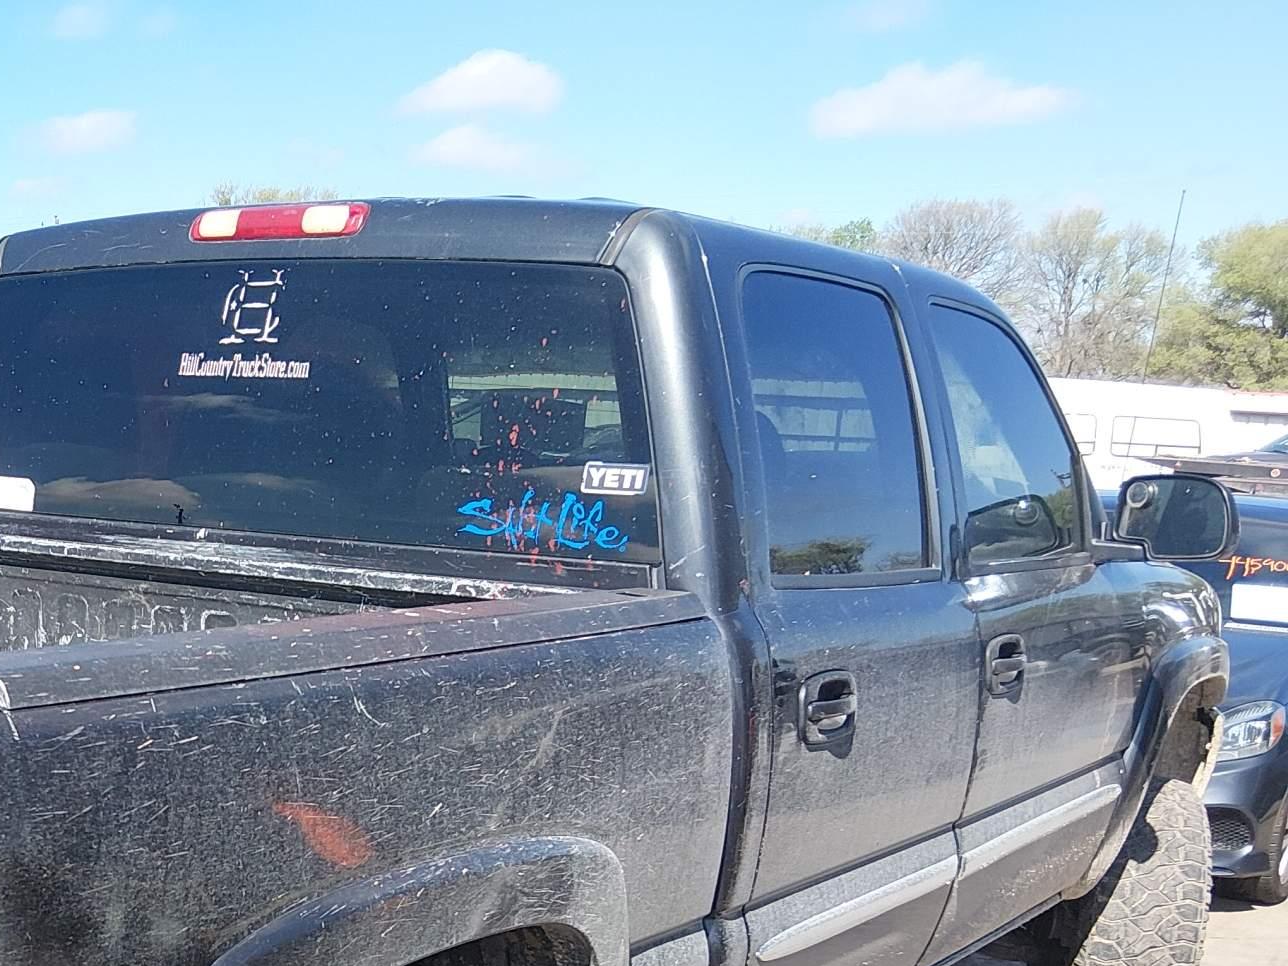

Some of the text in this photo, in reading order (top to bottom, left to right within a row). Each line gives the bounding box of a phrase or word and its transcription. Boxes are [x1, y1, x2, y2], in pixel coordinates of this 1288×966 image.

[178, 352, 310, 381] HillCountryTruckStore.com
[589, 467, 644, 490] YETI
[554, 491, 628, 550] Life
